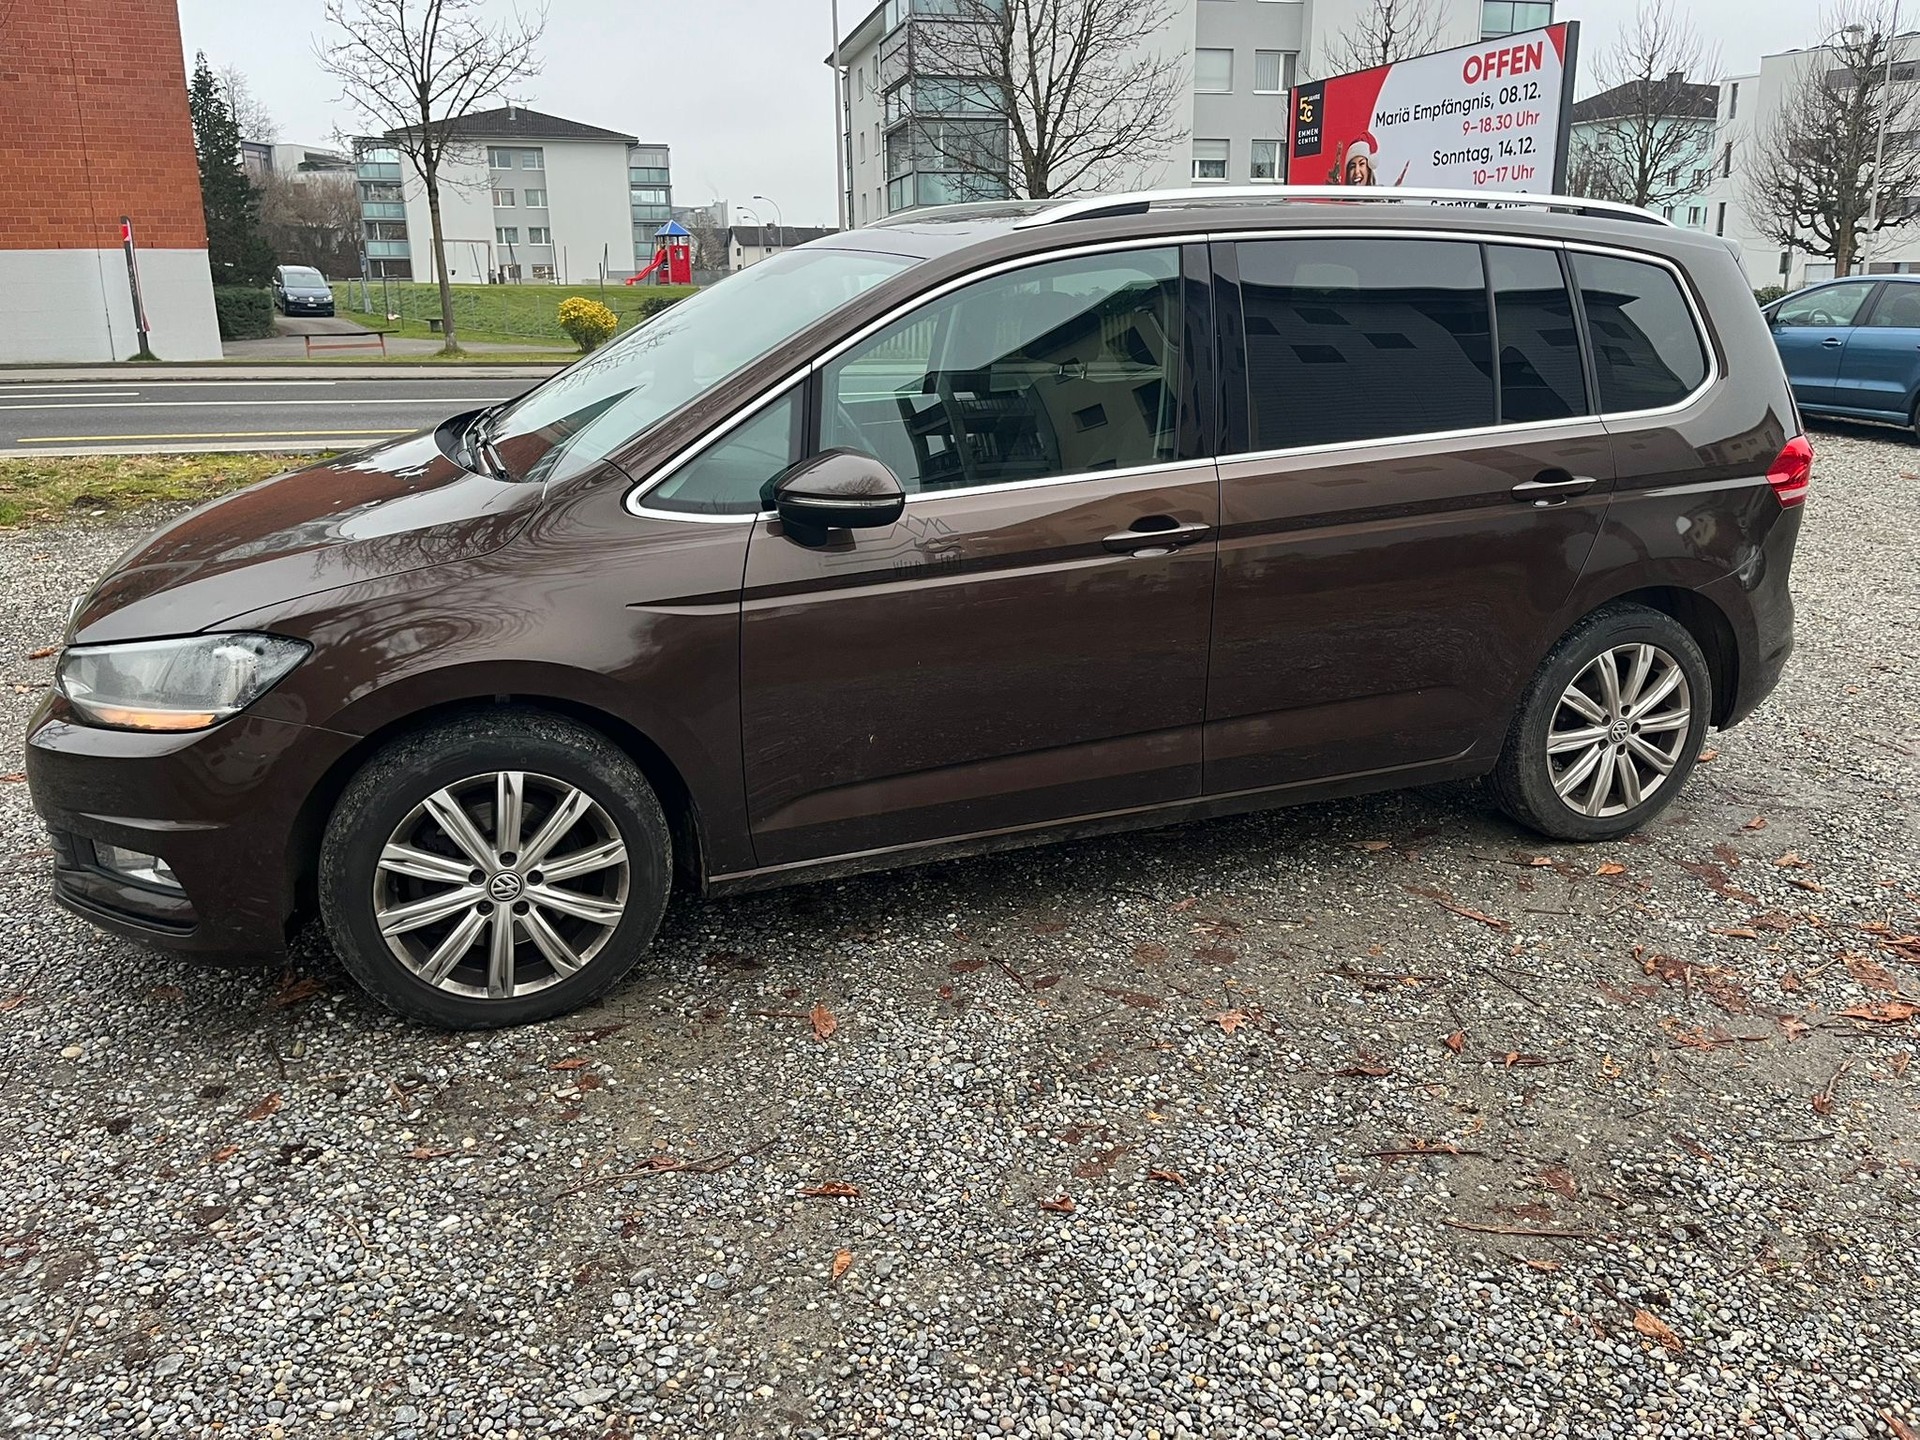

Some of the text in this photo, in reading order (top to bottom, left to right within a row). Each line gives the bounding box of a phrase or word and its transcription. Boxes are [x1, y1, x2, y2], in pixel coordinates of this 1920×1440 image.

[1463, 41, 1543, 84] OFFEN
[1375, 82, 1541, 128] Mariä Empfängnis, 08.12.
[1298, 128, 1318, 138] EMMEN
[1463, 110, 1540, 136] 9–18.30 Uhr
[1298, 136, 1318, 145] CENTER
[1432, 136, 1536, 167] Sonntag, 14.12.
[1473, 164, 1535, 185] 10–17 Uhr
